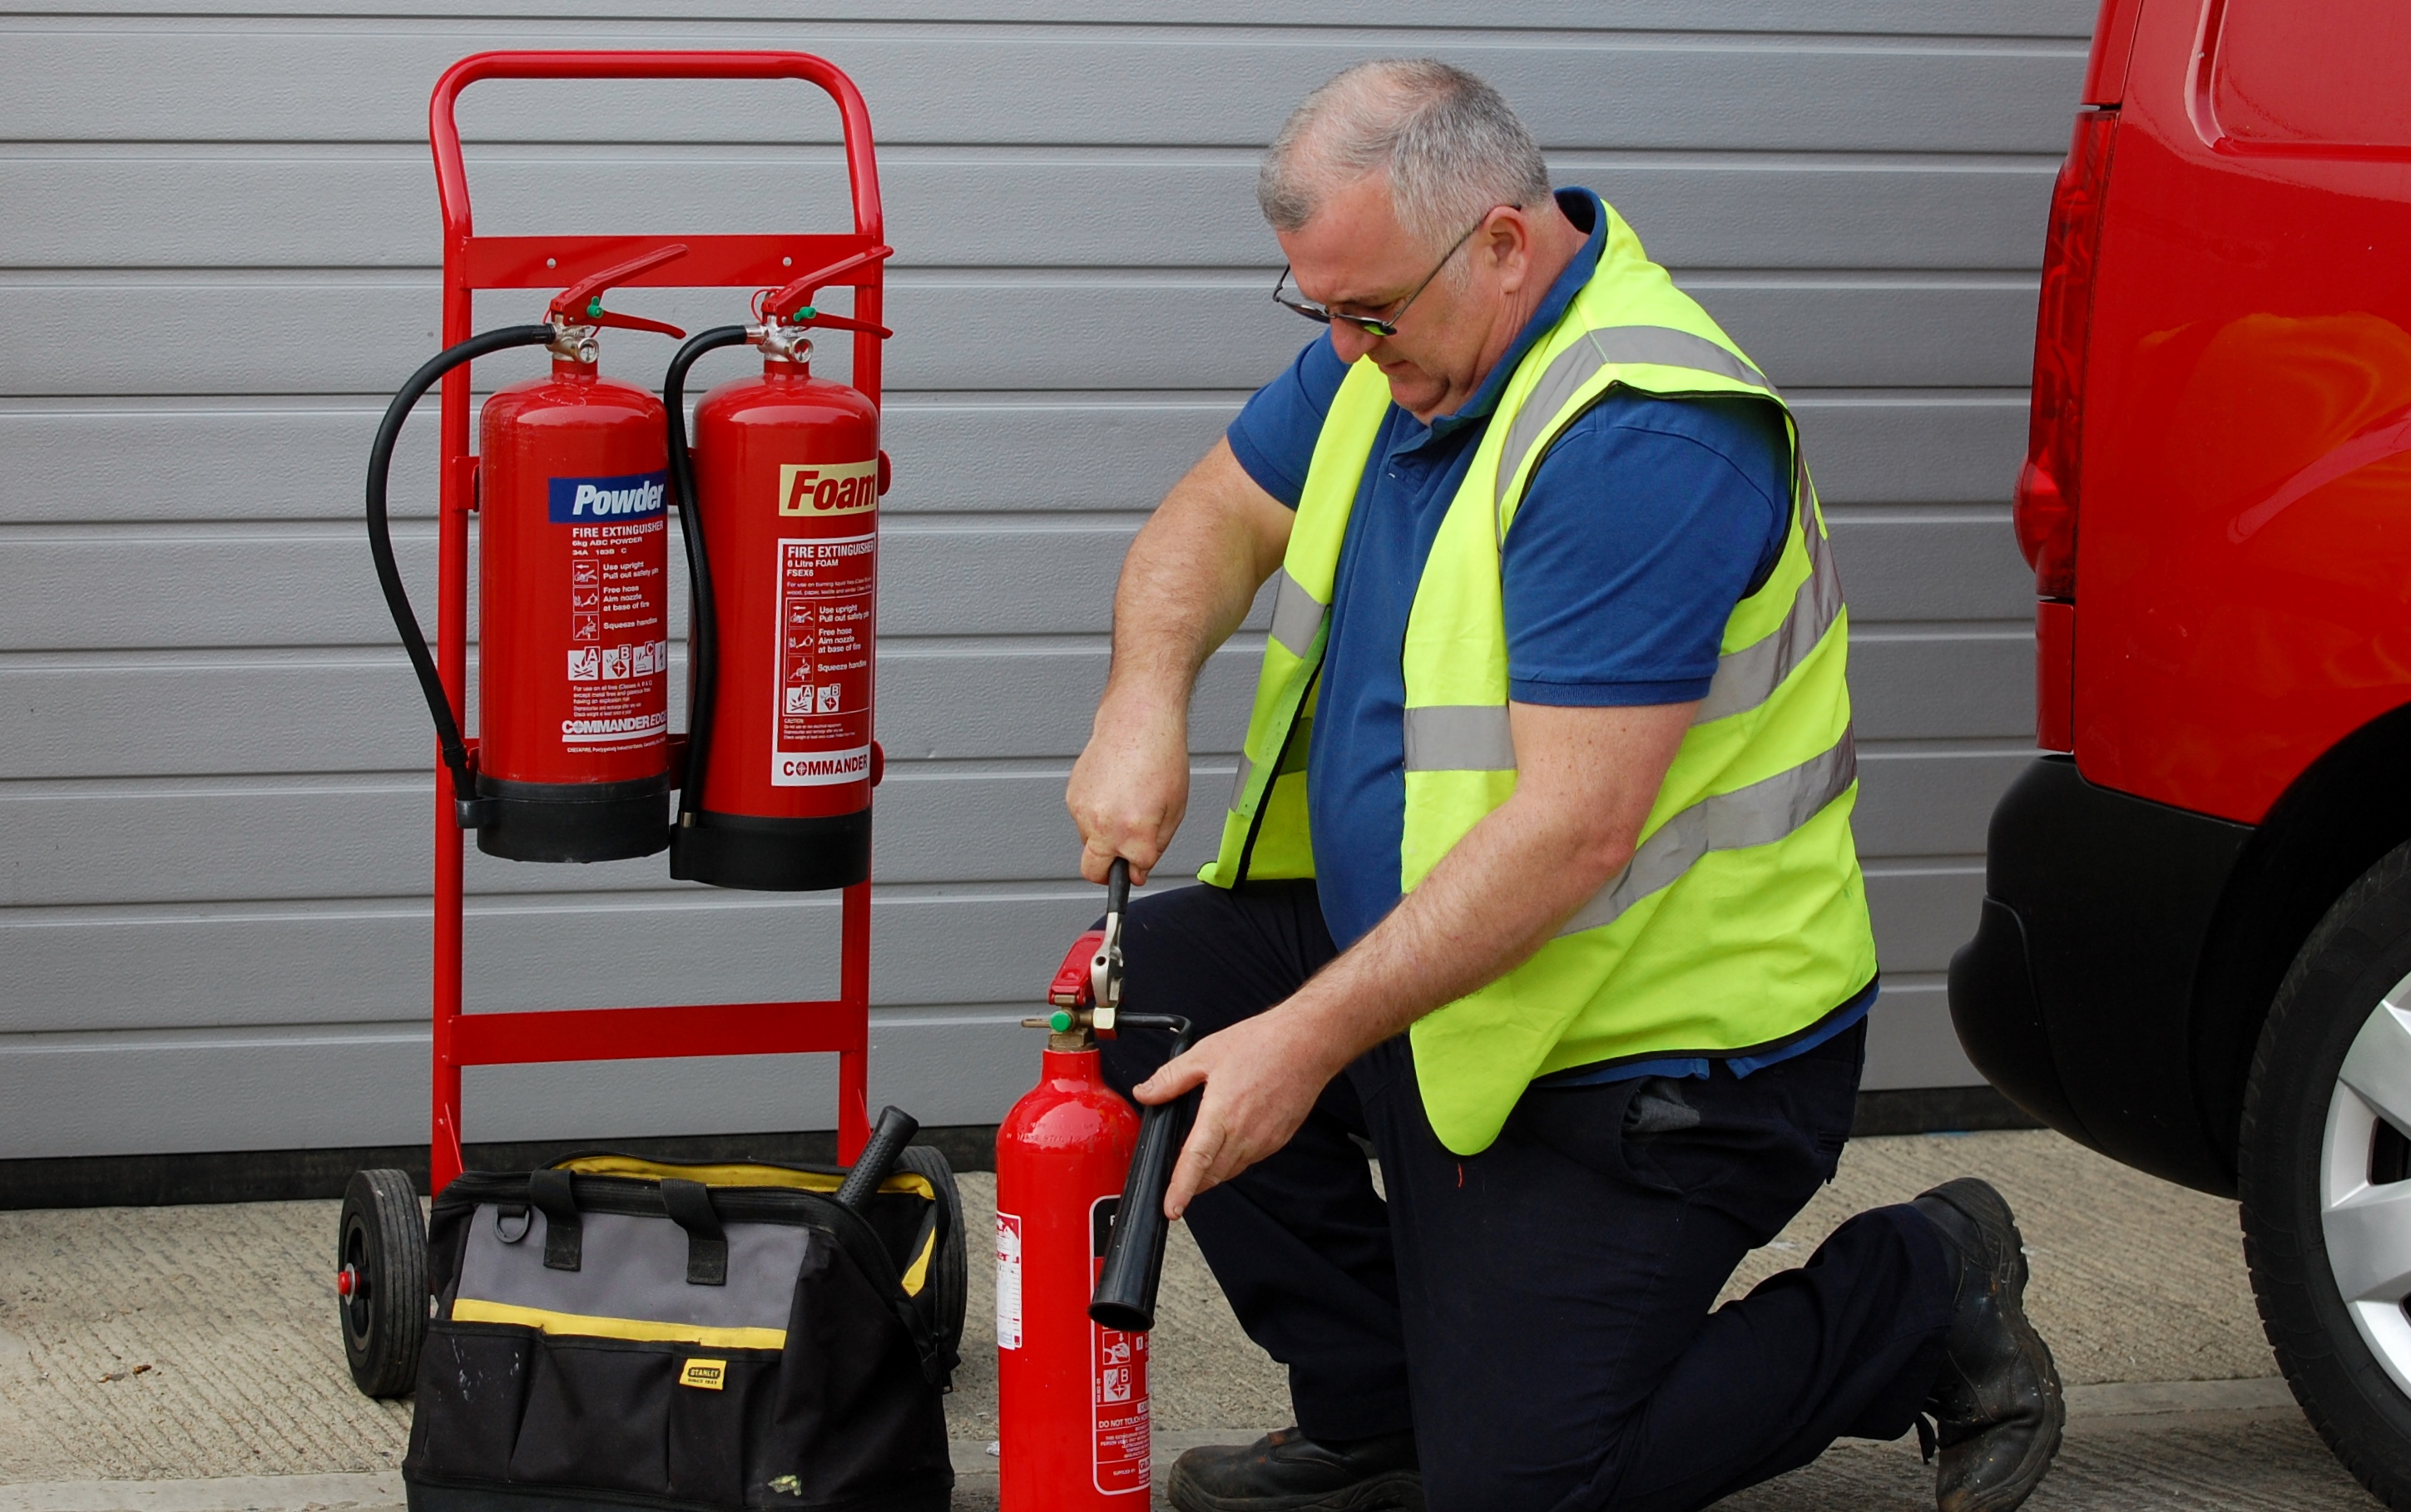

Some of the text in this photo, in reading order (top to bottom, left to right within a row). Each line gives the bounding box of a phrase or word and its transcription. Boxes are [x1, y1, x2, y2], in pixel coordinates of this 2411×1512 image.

[787, 470, 876, 511] Foam
[572, 480, 664, 516] Powder
[572, 520, 664, 538] FIRE EXTINGUISHER
[610, 536, 643, 545] POWDER
[787, 541, 874, 558] FIRE EXTINGUISHER
[620, 561, 645, 571] upright
[815, 559, 839, 567] FOAM
[819, 604, 858, 615] Use upright
[819, 615, 834, 623] Pull
[603, 622, 635, 630] Squeeze
[819, 627, 852, 636] Free hose
[834, 635, 854, 644] nozzle
[587, 643, 654, 661] A B C
[818, 645, 826, 654] at
[817, 663, 848, 673] Squeeze
[804, 685, 839, 697] A B
[562, 715, 650, 734] COMMANDER
[783, 754, 868, 777] COMMANDER
[690, 1368, 719, 1377] STANLEY
[1121, 1368, 1129, 1382] B
[1098, 1421, 1110, 1429] DO
[1111, 1419, 1124, 1427] NOT
